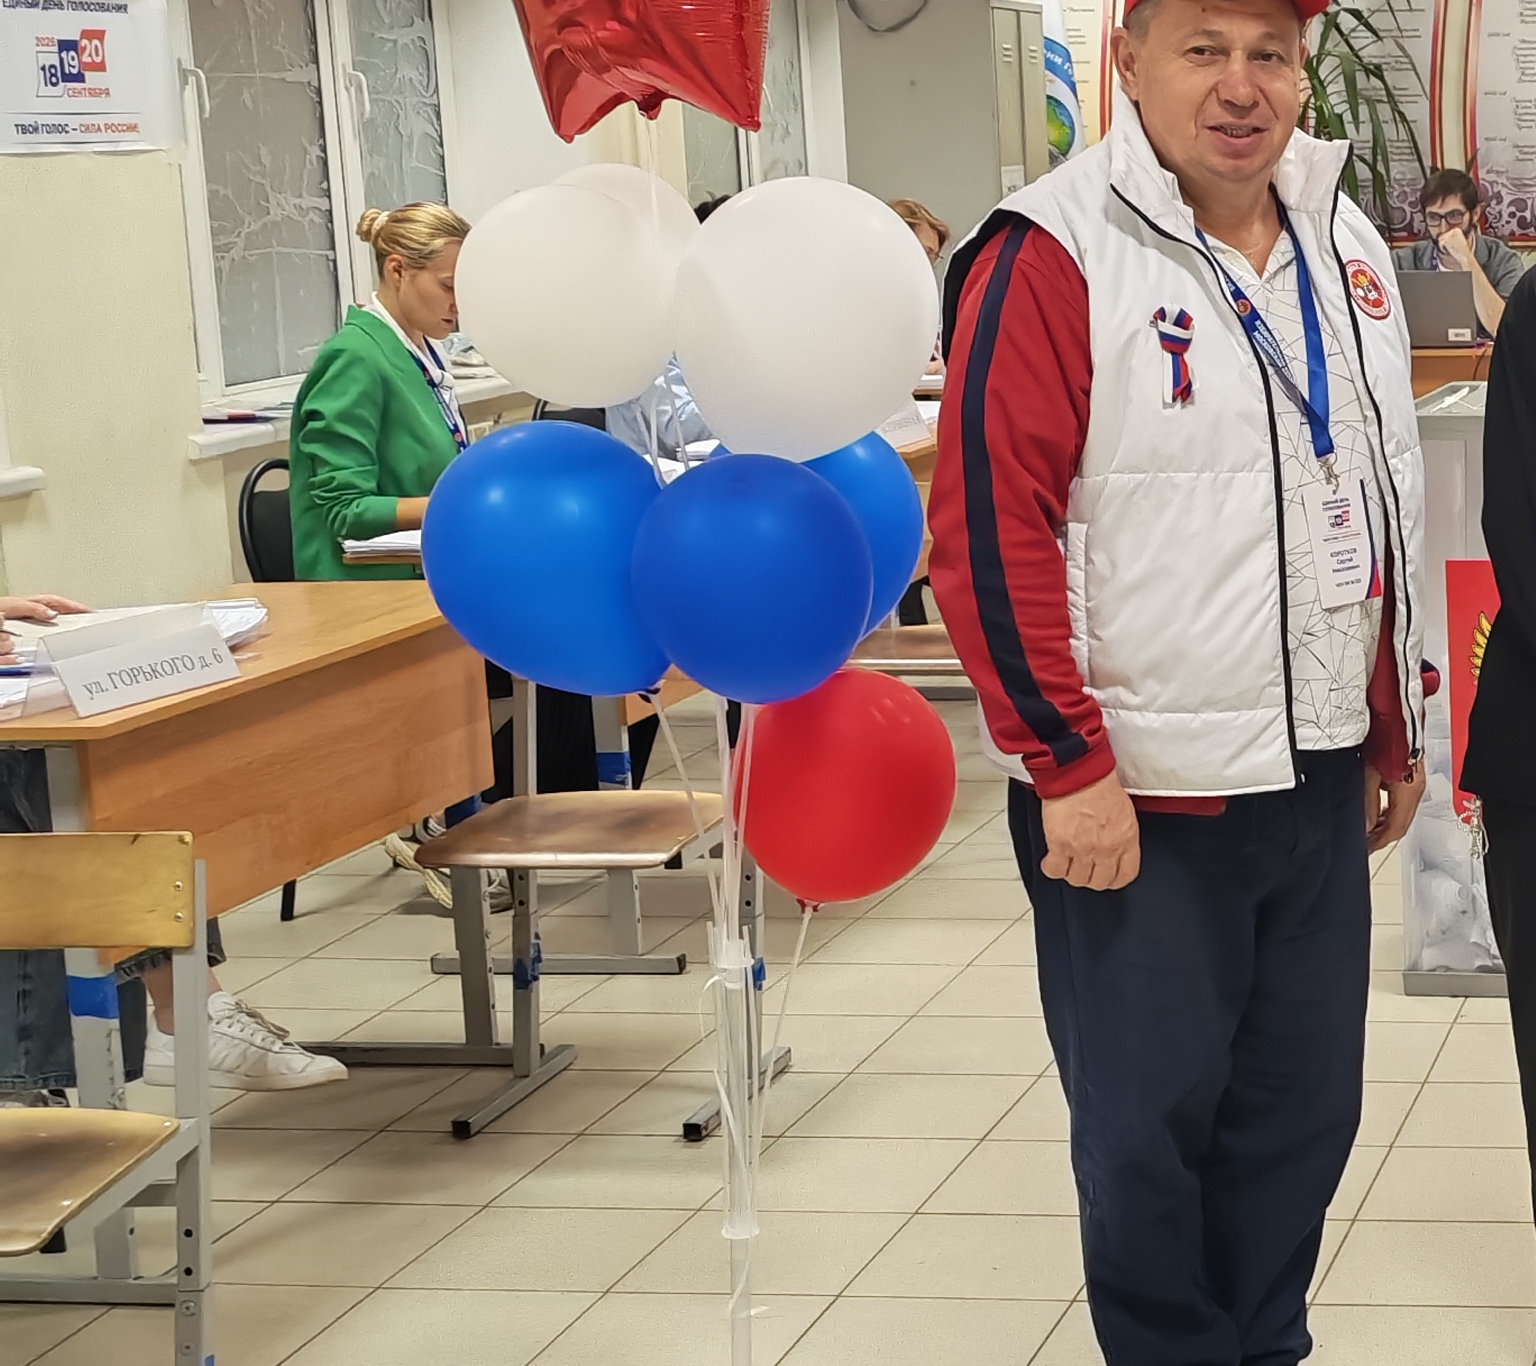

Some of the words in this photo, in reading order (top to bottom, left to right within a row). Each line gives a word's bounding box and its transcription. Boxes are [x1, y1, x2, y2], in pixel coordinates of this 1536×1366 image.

[66, 0, 129, 15] ГОЛОСОВАНИЯ
[60, 50, 79, 74] 19
[81, 38, 103, 63] 20
[40, 63, 60, 88] 18
[14, 120, 39, 135] ТВОЙ
[41, 123, 70, 135] ГОЛОС
[82, 681, 108, 701] ул.
[106, 654, 196, 690] ГОРЬКОГО
[198, 655, 213, 671] д.
[211, 647, 224, 664] 6
